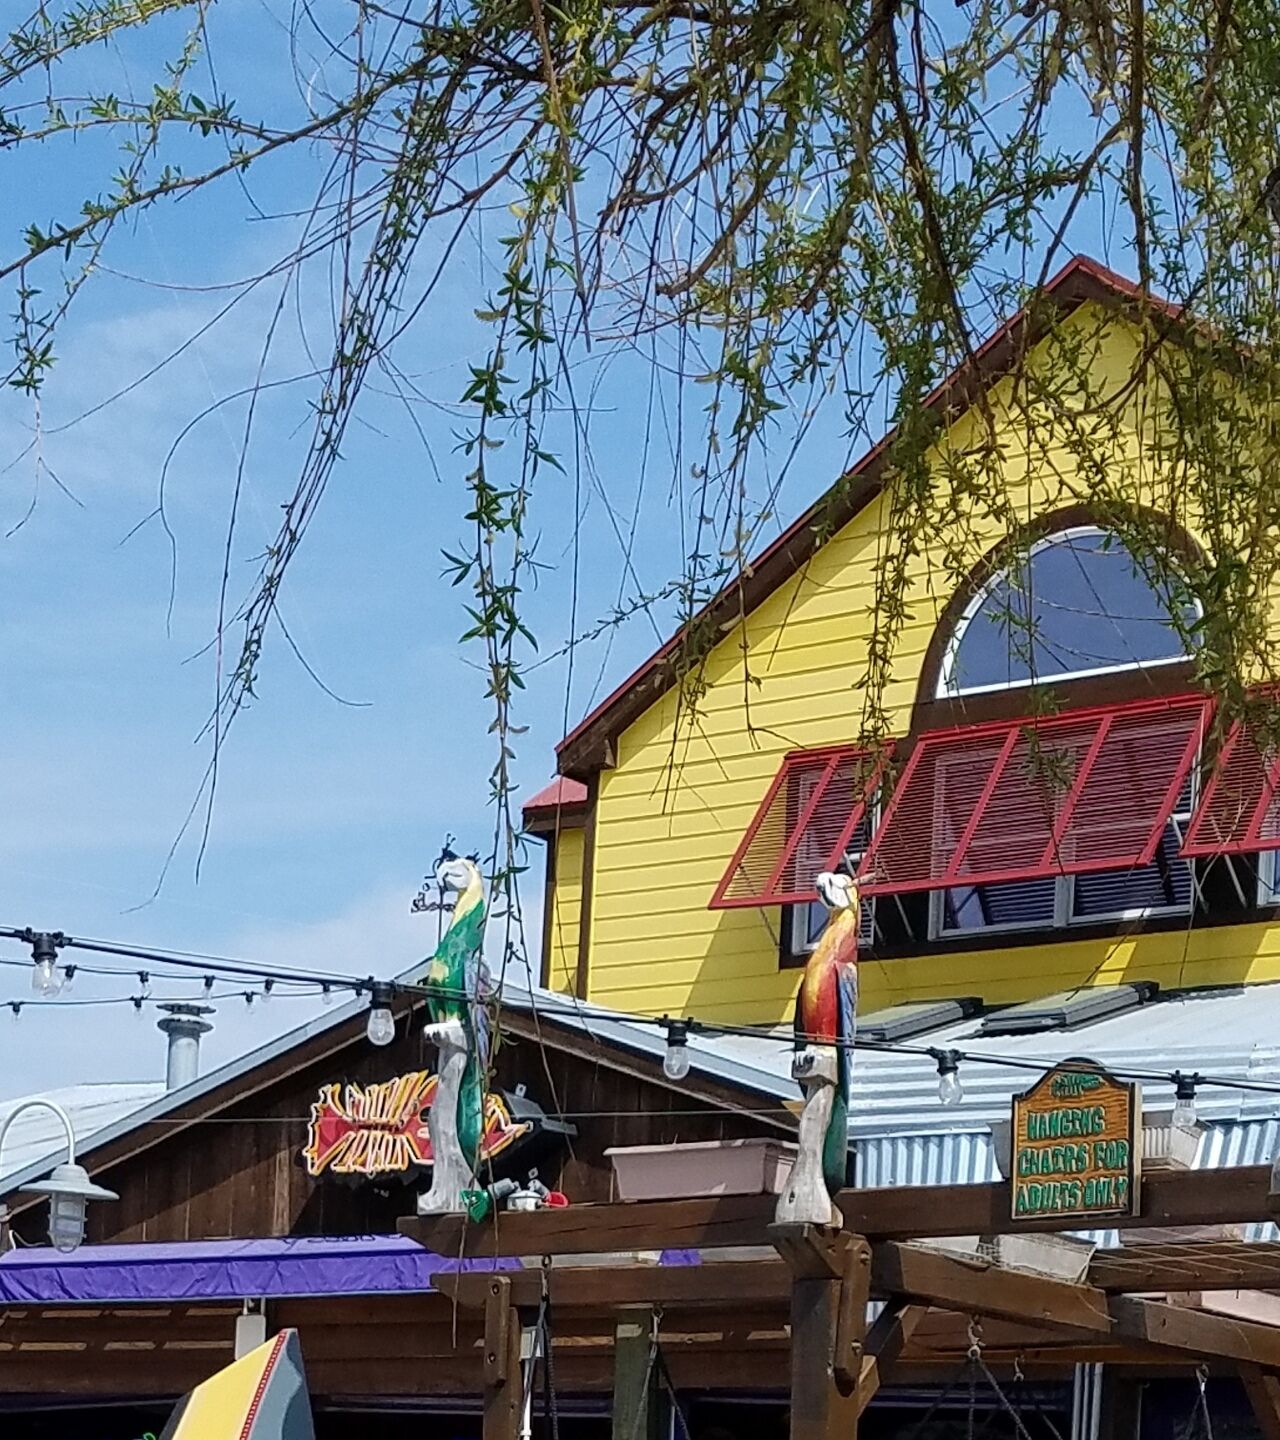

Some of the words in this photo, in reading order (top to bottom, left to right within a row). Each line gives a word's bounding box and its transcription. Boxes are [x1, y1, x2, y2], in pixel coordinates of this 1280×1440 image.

[1027, 1106, 1105, 1140] HANGING
[1018, 1143, 1089, 1177] CHAIRS
[1093, 1139, 1130, 1170] FOR
[1017, 1181, 1083, 1213] ADULTS
[1083, 1177, 1129, 1208] ONLY
